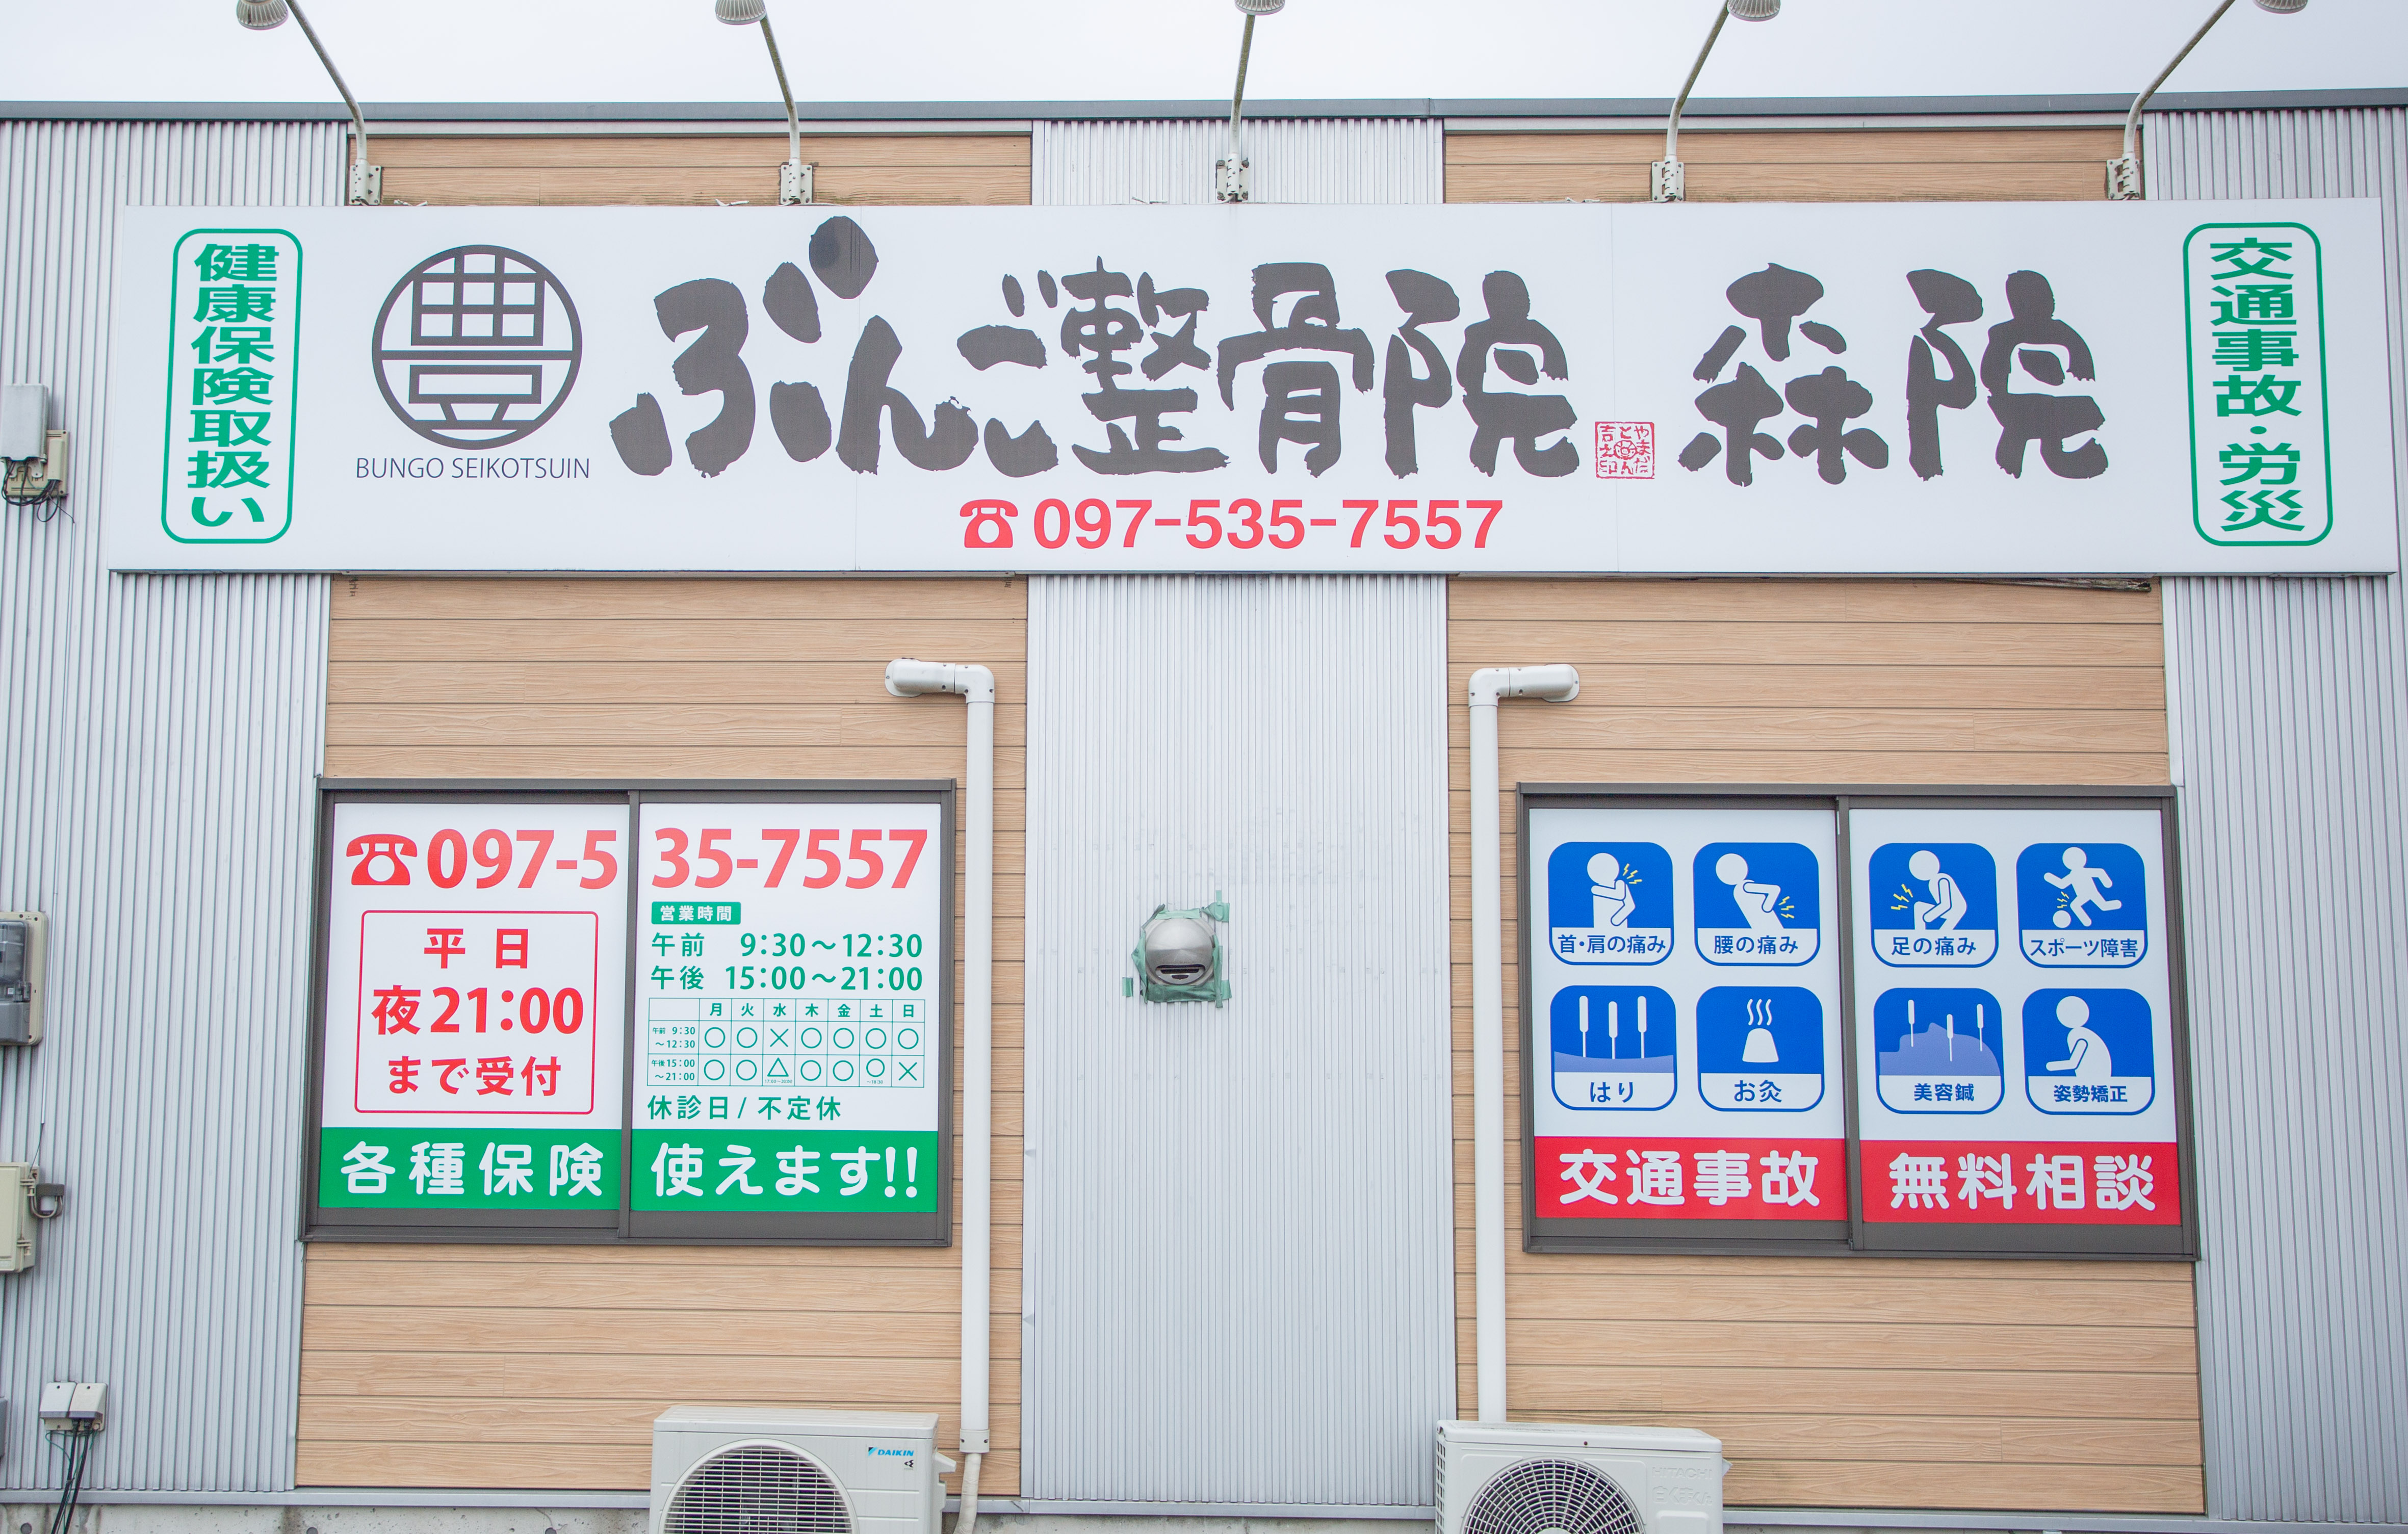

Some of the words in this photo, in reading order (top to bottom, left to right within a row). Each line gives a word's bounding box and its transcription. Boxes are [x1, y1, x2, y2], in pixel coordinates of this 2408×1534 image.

[609, 216, 1580, 480] ぶんご整骨院
[1677, 263, 2108, 487] 森院
[187, 243, 279, 527] 健康保険取扱い
[2209, 237, 2306, 532] 交通事故・労災
[356, 457, 444, 478] BUNGO
[452, 457, 589, 479] SEIKOTSUIN
[1033, 498, 1503, 550] 097-535-7557
[427, 828, 617, 890] 097-5
[652, 827, 927, 889] 35-7557
[660, 905, 732, 922] 営業時間
[424, 928, 529, 969] 平日
[652, 932, 705, 957] 午前
[1558, 934, 1667, 955] 首・肩の痛み
[1714, 935, 1799, 955] 腰の痛み
[1891, 936, 1977, 957] 足の痛み
[2030, 937, 2139, 958] スポーツ障害
[651, 965, 704, 990] 午後
[709, 1003, 722, 1017] 月
[741, 1003, 754, 1017] 火
[773, 1003, 786, 1017] 水
[805, 1003, 819, 1017] 木
[837, 1003, 851, 1018] 金
[869, 1004, 883, 1018] 土
[903, 1004, 914, 1018] 日
[652, 1027, 666, 1035] 午前
[671, 1026, 696, 1035] 9:30
[388, 1055, 561, 1097] まで受付
[1590, 1081, 1634, 1103] はり
[1734, 1079, 1782, 1103] お灸
[1914, 1083, 1975, 1102] 美容鍼
[2054, 1084, 2128, 1103] 姿勢矯正
[341, 1141, 604, 1197] 各種保険
[651, 1142, 918, 1198] 使えます!!
[1559, 1148, 1820, 1207] 交通事故
[1888, 1152, 2156, 1211] 無料相談
[1652, 1467, 1713, 1479] HITACHI
